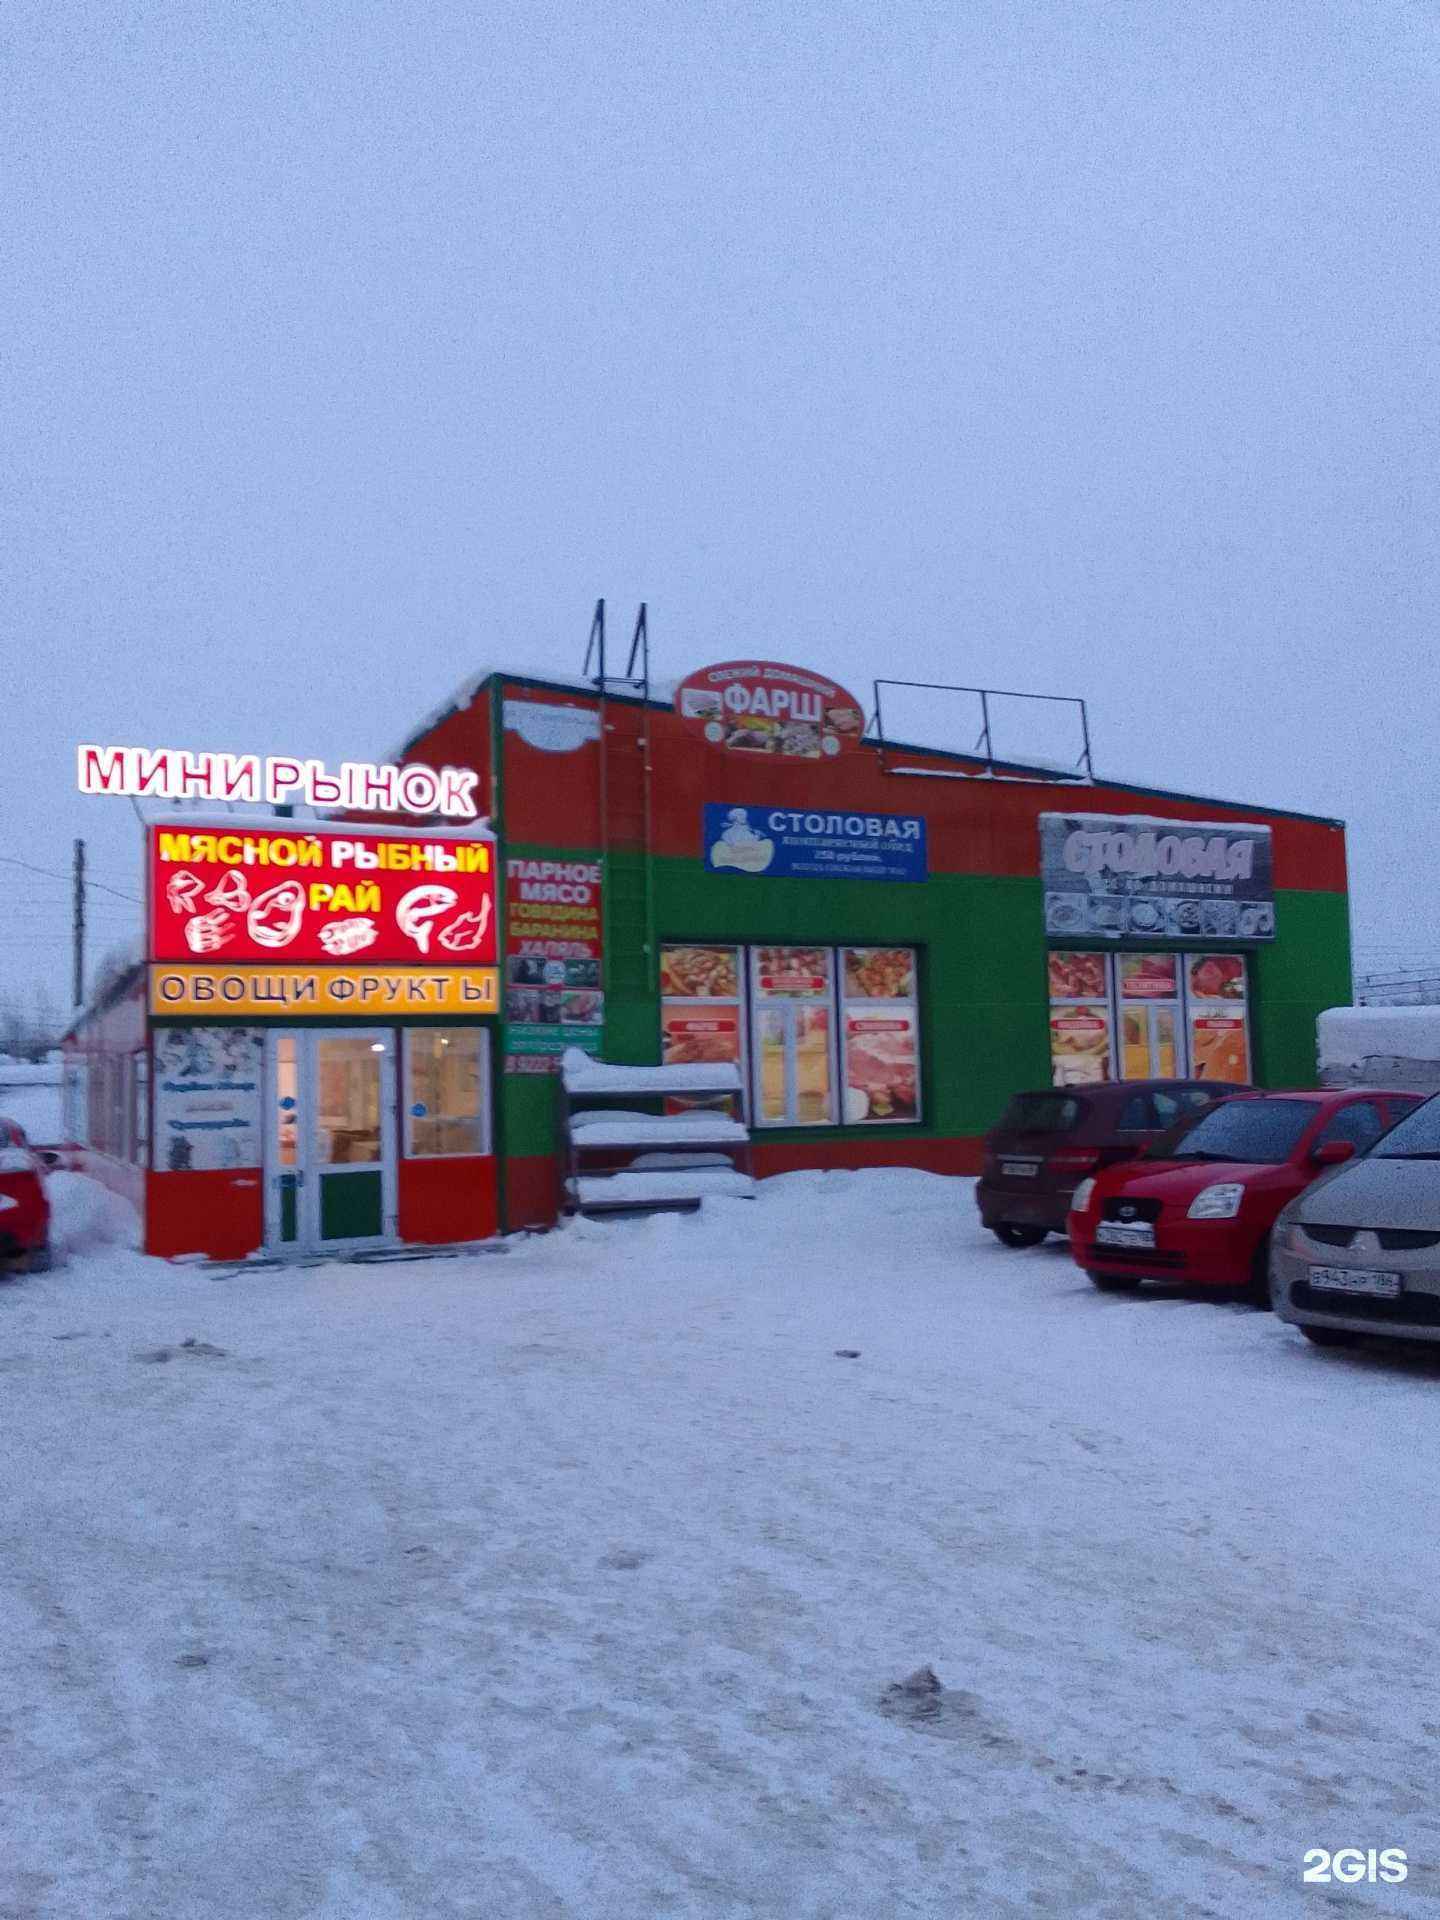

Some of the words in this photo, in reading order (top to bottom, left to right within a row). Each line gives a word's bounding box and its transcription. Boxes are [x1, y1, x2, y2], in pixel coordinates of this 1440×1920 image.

[724, 683, 822, 722] ФАРШ
[768, 812, 921, 839] СТОЛОВАЯ
[159, 833, 322, 868] МЯСНОЙ
[331, 840, 490, 874] РЫБНЫЙ
[1063, 830, 1253, 880] СТОЛОВАЯ
[507, 860, 602, 883] ПАРНОЕ
[309, 880, 381, 912] РАЙ
[521, 881, 591, 904] МЯСО
[160, 976, 316, 1006] ОВОЩИ
